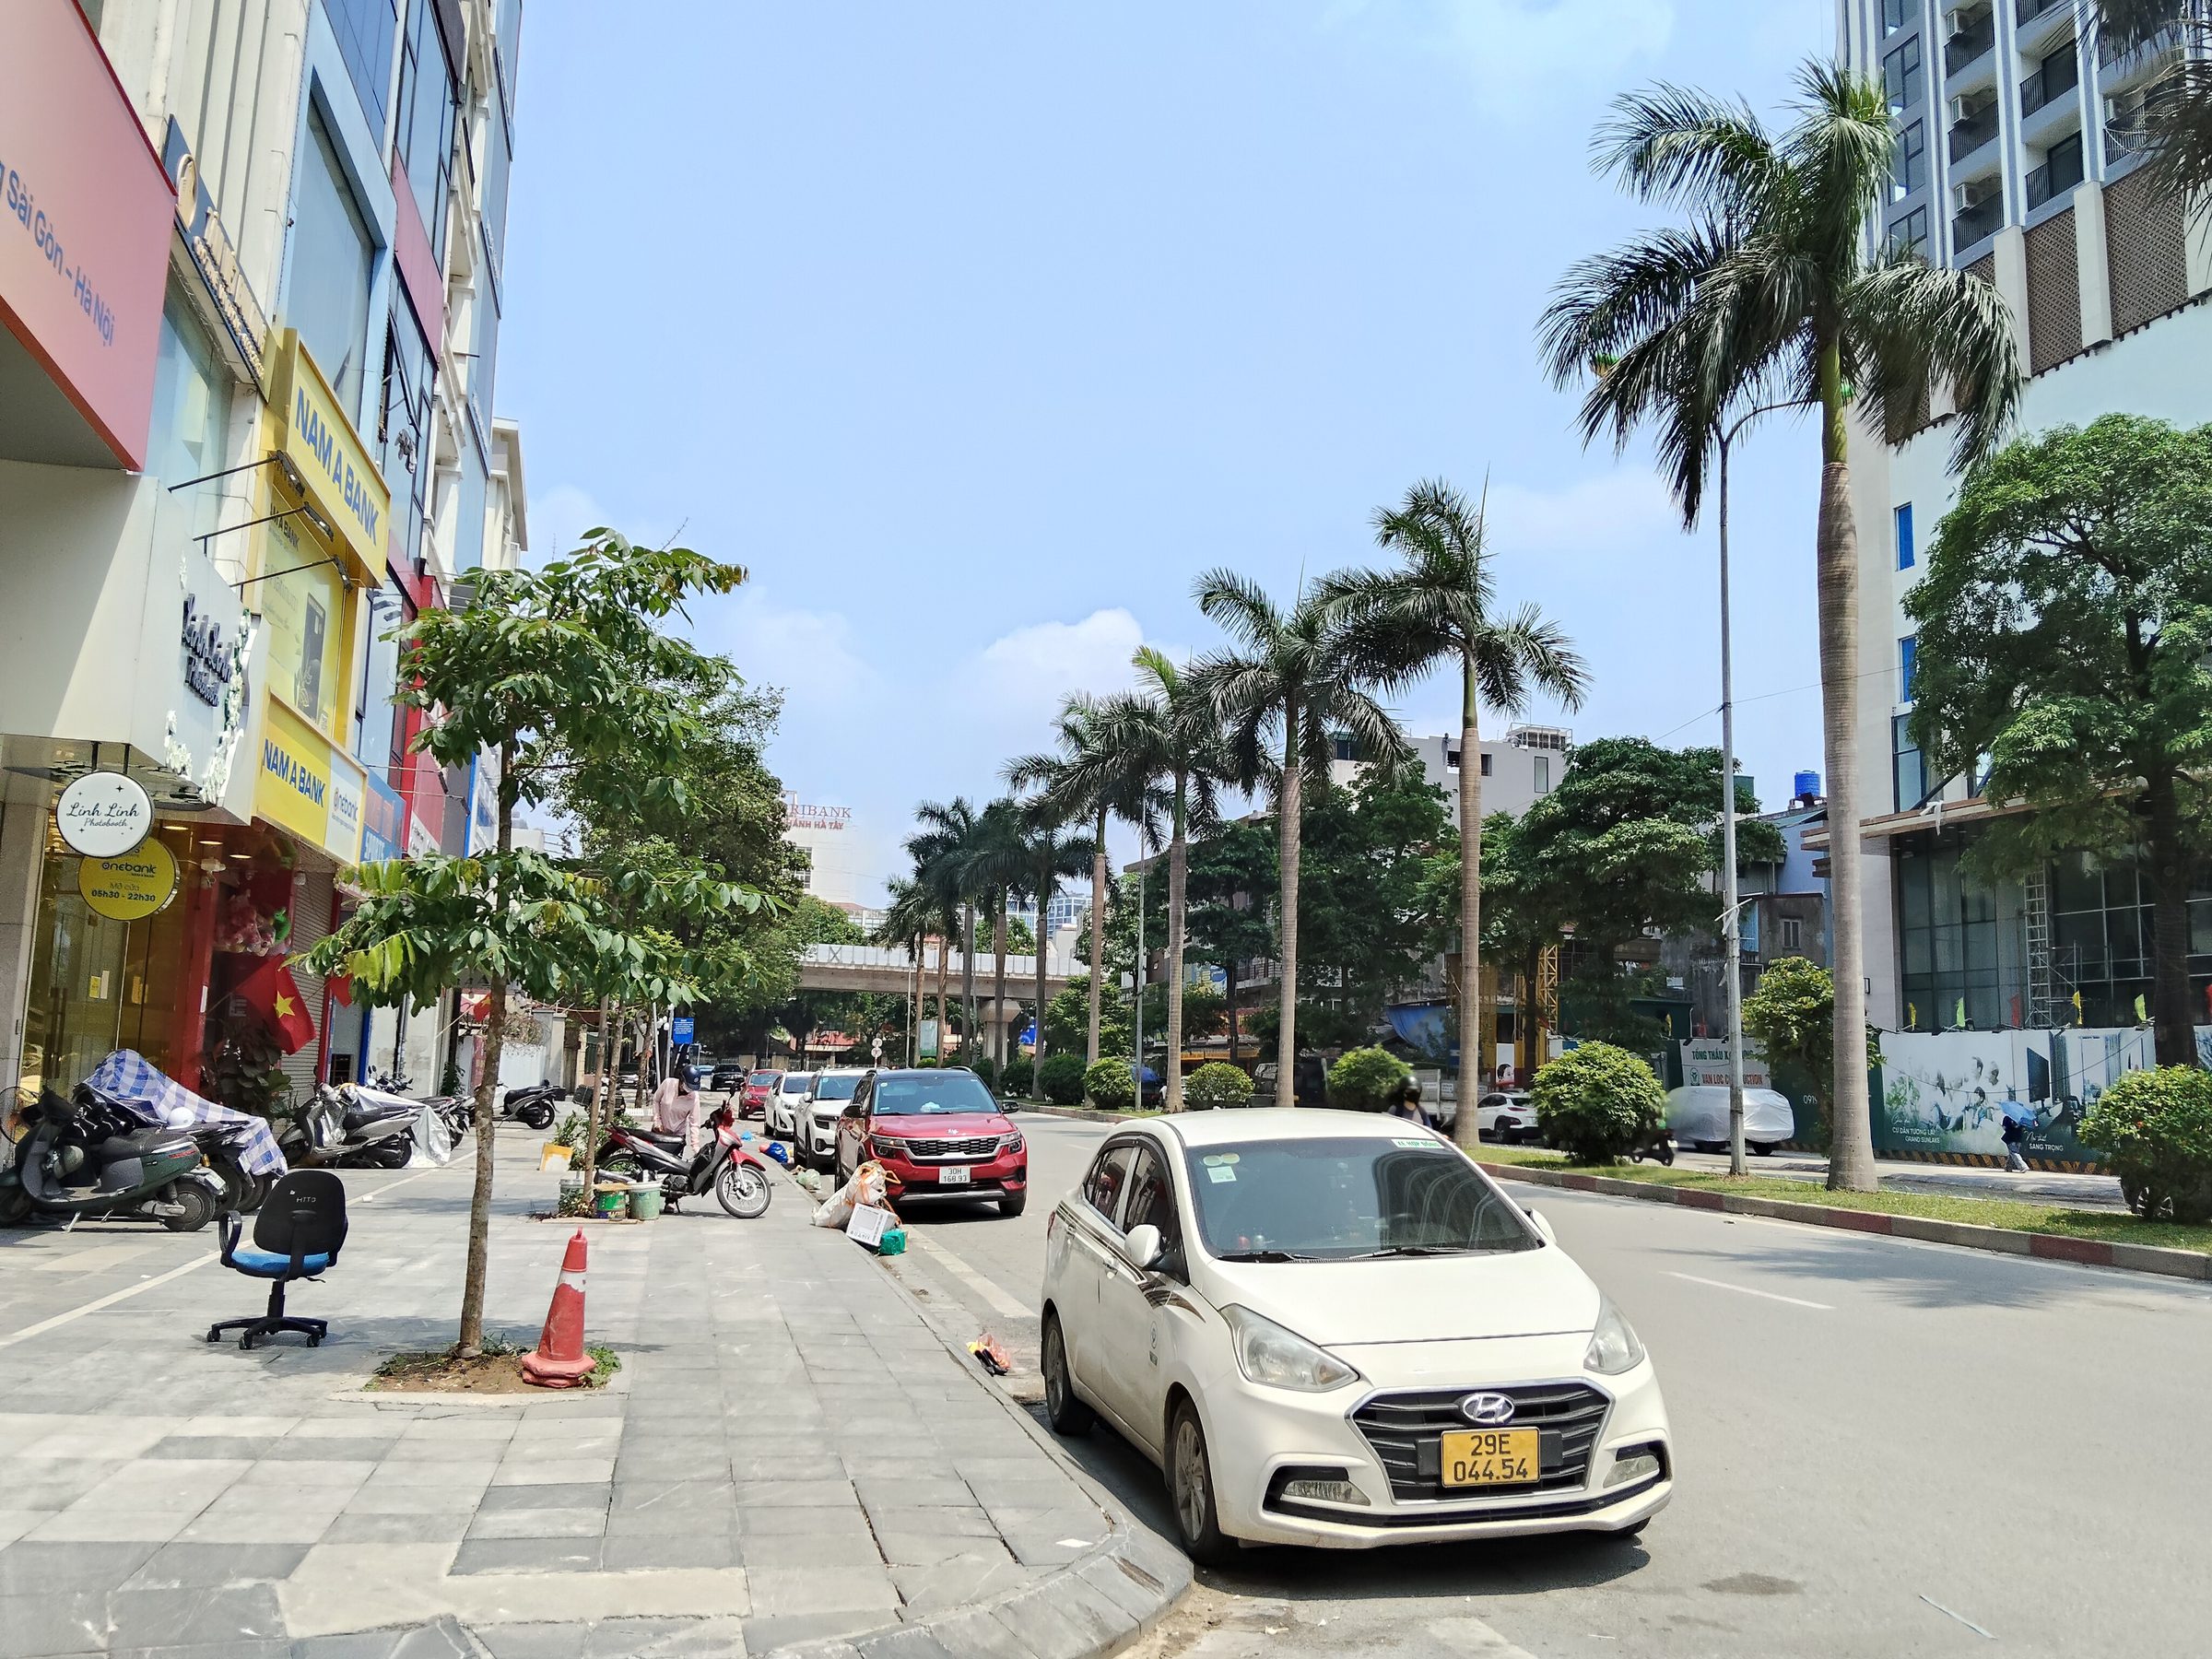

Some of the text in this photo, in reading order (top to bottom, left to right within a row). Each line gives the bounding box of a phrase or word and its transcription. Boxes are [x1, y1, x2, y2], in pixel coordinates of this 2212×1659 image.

[7, 170, 33, 230] Sài
[34, 210, 64, 276] Gòn
[74, 265, 92, 316] Hà
[93, 293, 115, 347] Nội
[295, 385, 380, 547] NAM A BANK
[263, 738, 326, 808] NAM A BANK
[66, 802, 140, 818] Linh Linh
[790, 804, 852, 818] RIBANK
[84, 818, 128, 827] Photobooth
[91, 889, 120, 899] 05h30
[127, 892, 156, 902] 22h30
[1691, 1047, 1708, 1060] TỔNG
[2045, 1144, 2065, 1153] TRỌNG
[1470, 1434, 1512, 1456] 29E
[1453, 1458, 1528, 1482] 044.54
